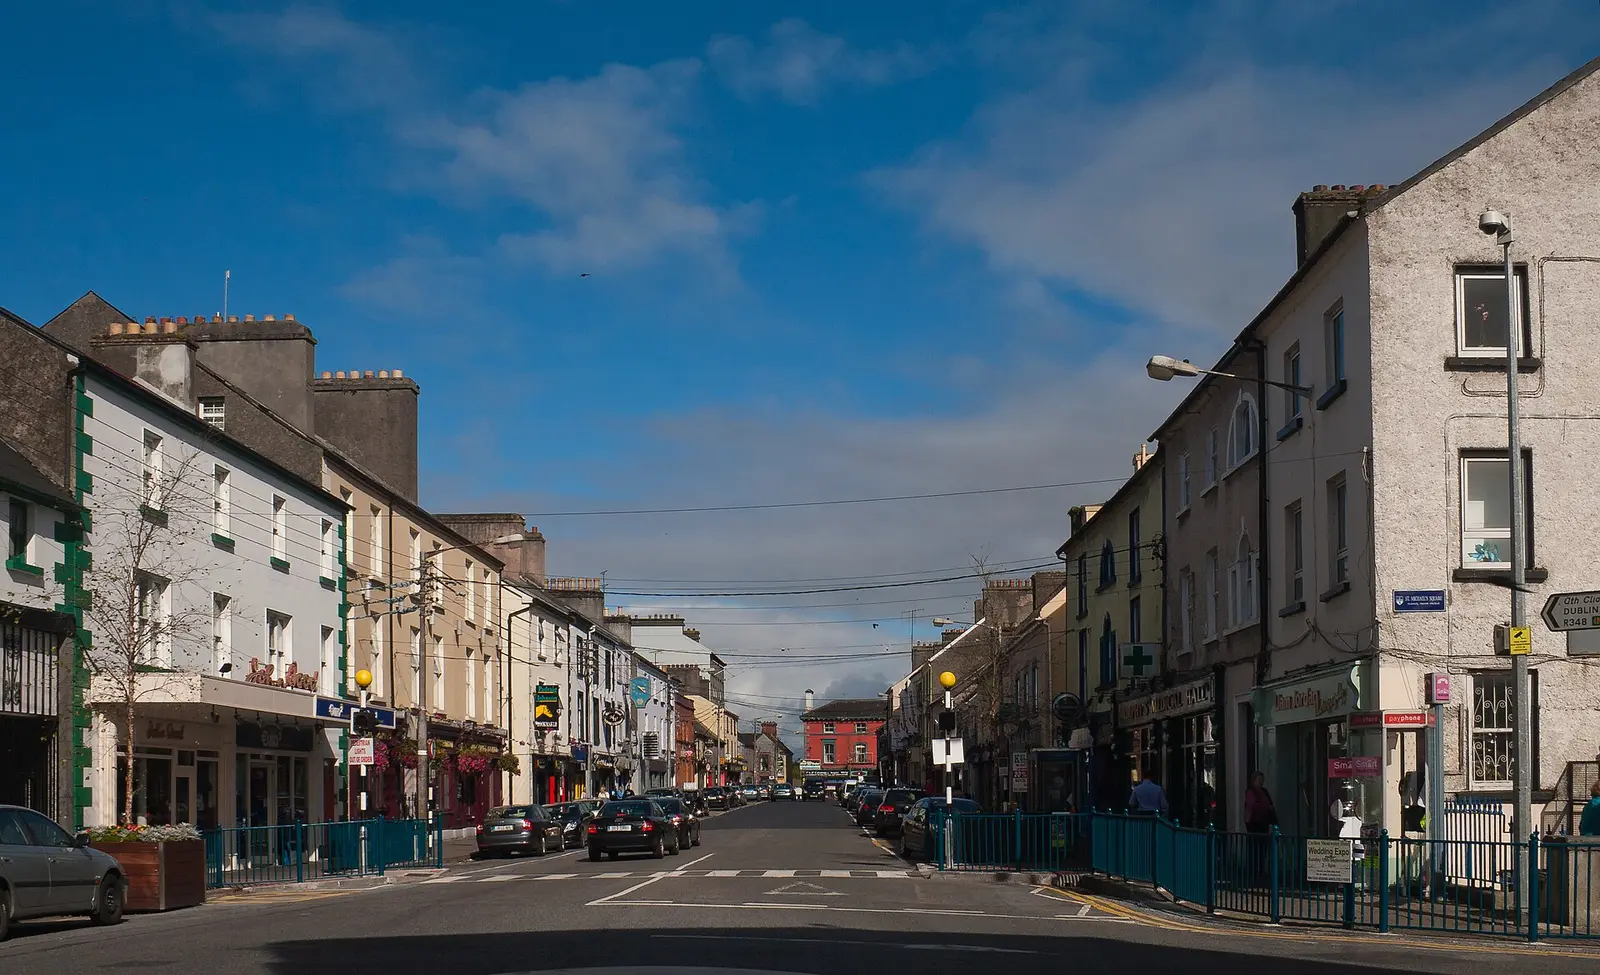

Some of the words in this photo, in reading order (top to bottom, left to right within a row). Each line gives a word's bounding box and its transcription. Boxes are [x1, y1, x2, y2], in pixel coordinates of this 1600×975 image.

[1563, 606, 1599, 615] DUBLIN
[1563, 618, 1587, 627] R348
[1186, 684, 1209, 705] HALL
[1388, 714, 1421, 723] payphone
[1308, 847, 1334, 855] Wedding
[1334, 847, 1350, 856] Expo
